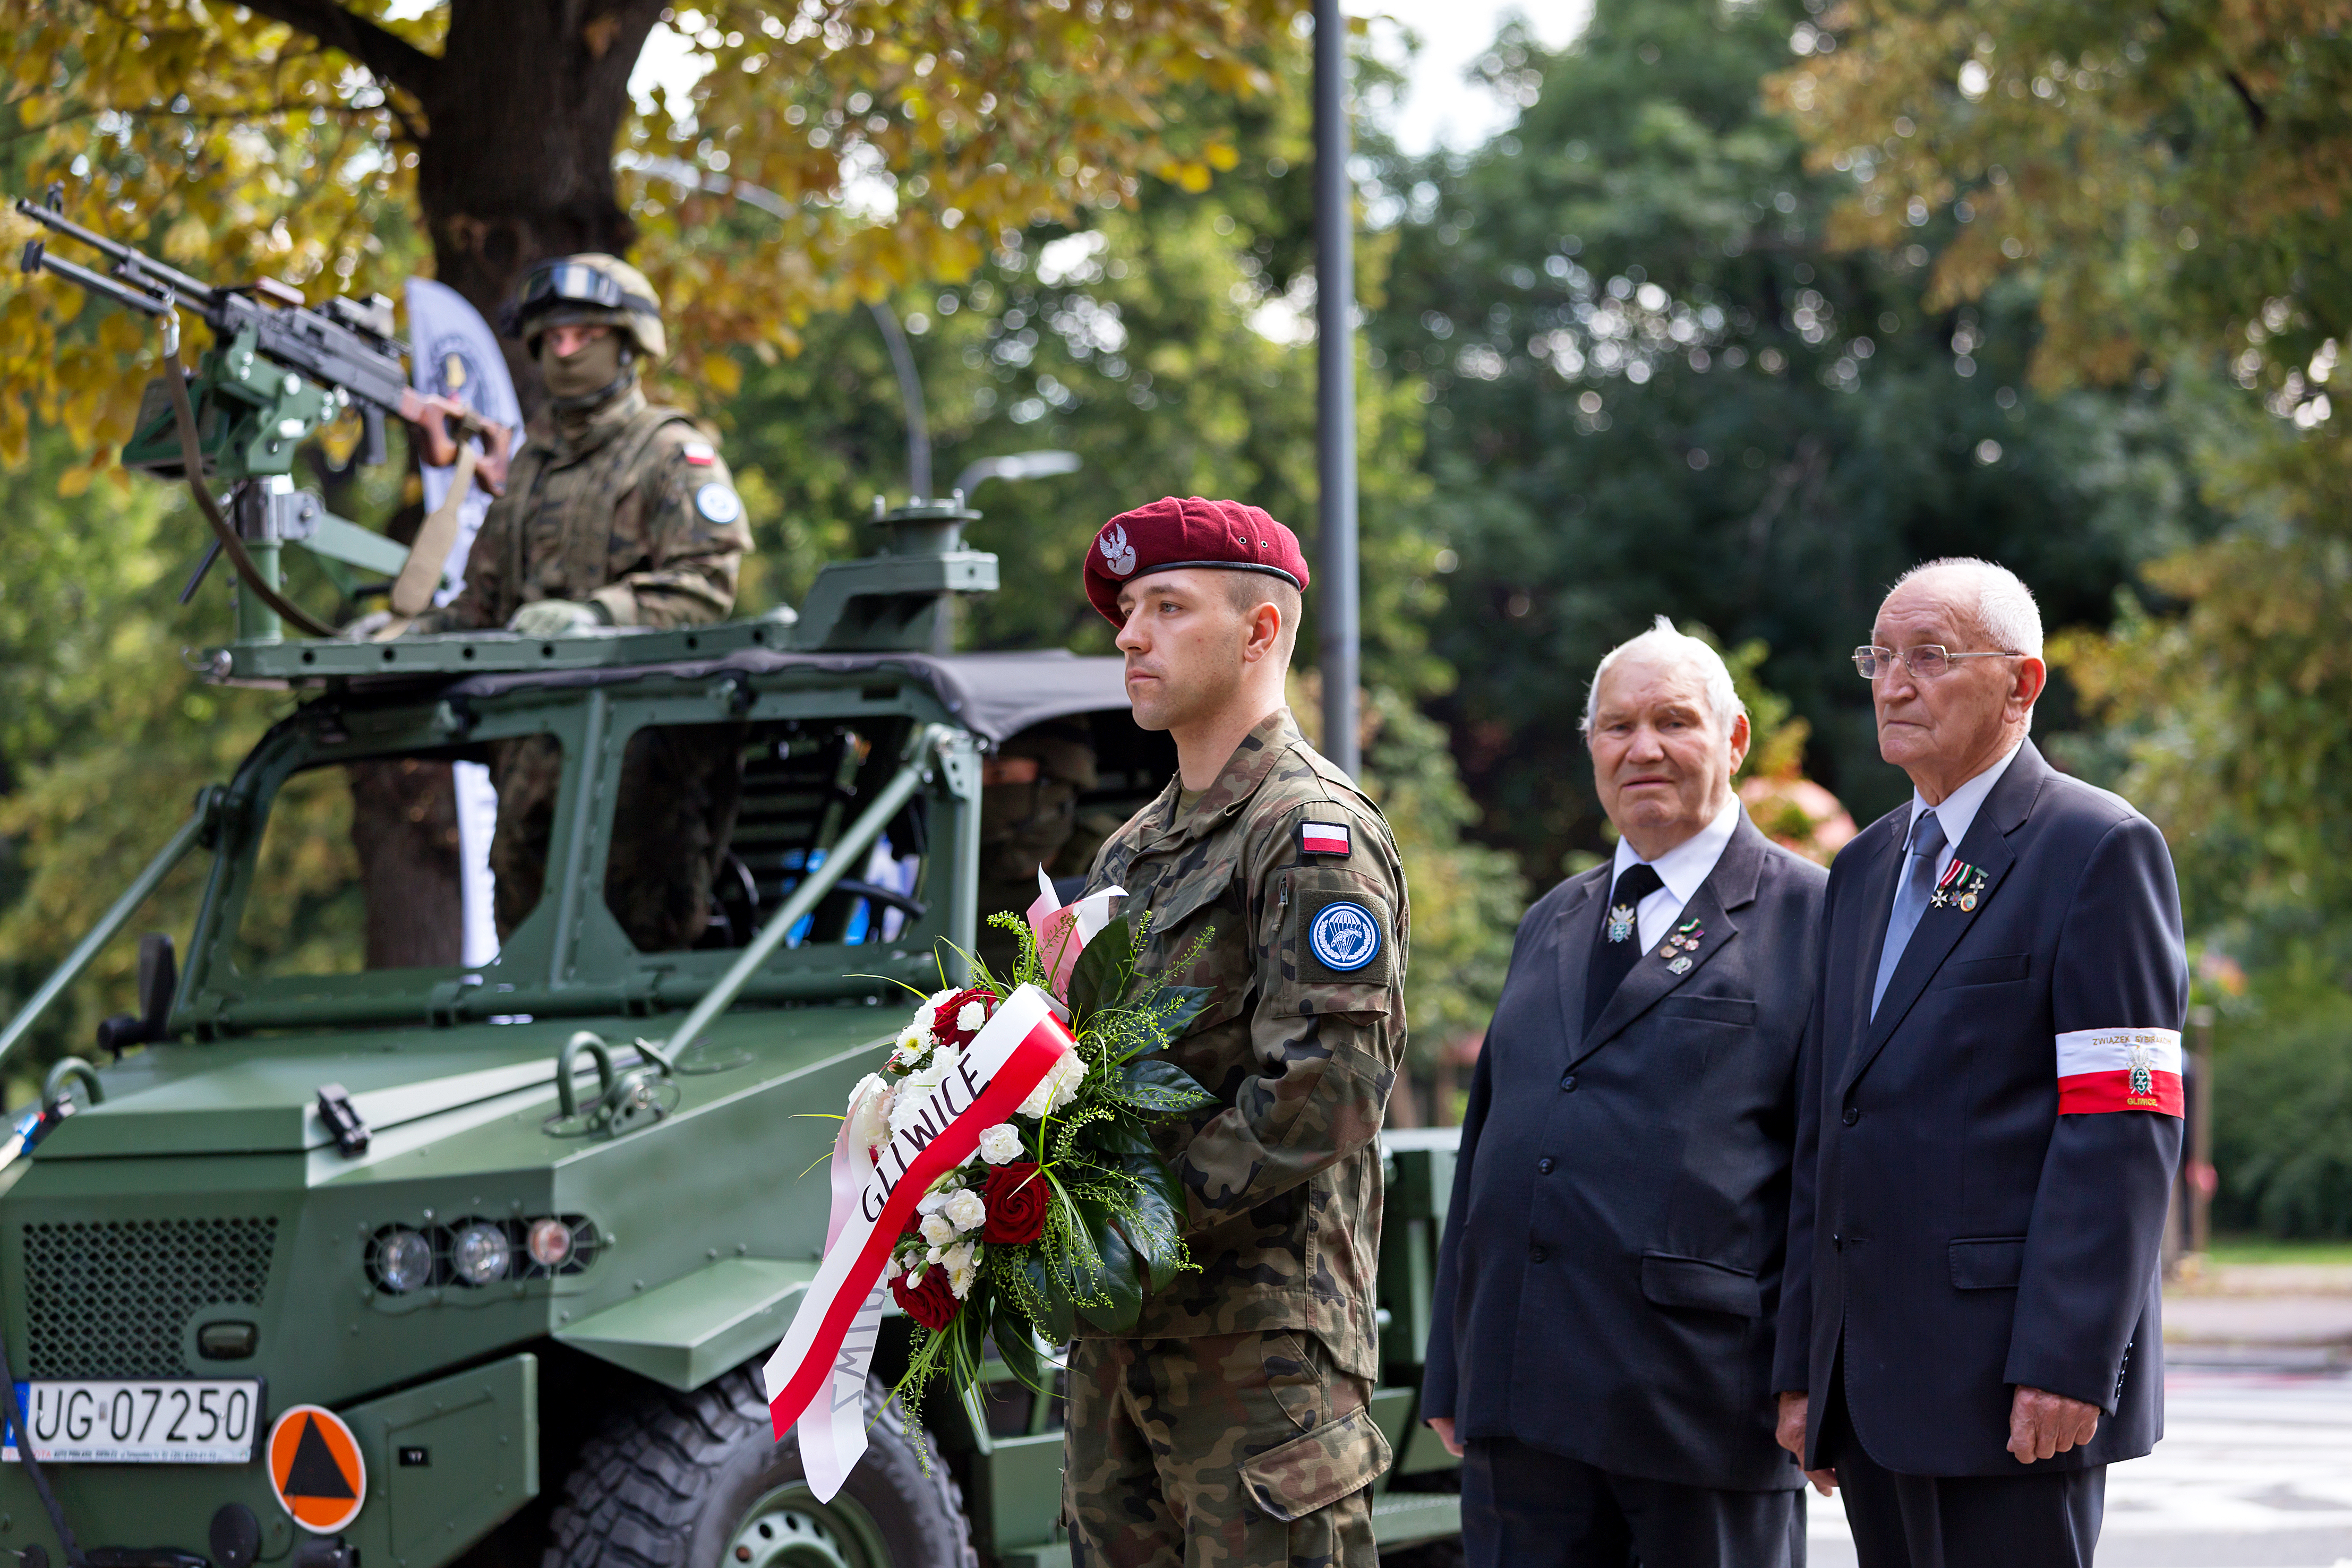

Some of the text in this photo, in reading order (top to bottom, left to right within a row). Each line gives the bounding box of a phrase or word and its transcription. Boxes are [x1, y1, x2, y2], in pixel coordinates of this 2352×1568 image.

[2092, 1035, 2130, 1046] ZWIĄZEK
[2127, 1098, 2157, 1107] GLIWICE
[862, 1052, 991, 1223] GLIWICE
[36, 1387, 250, 1443] UG 07250
